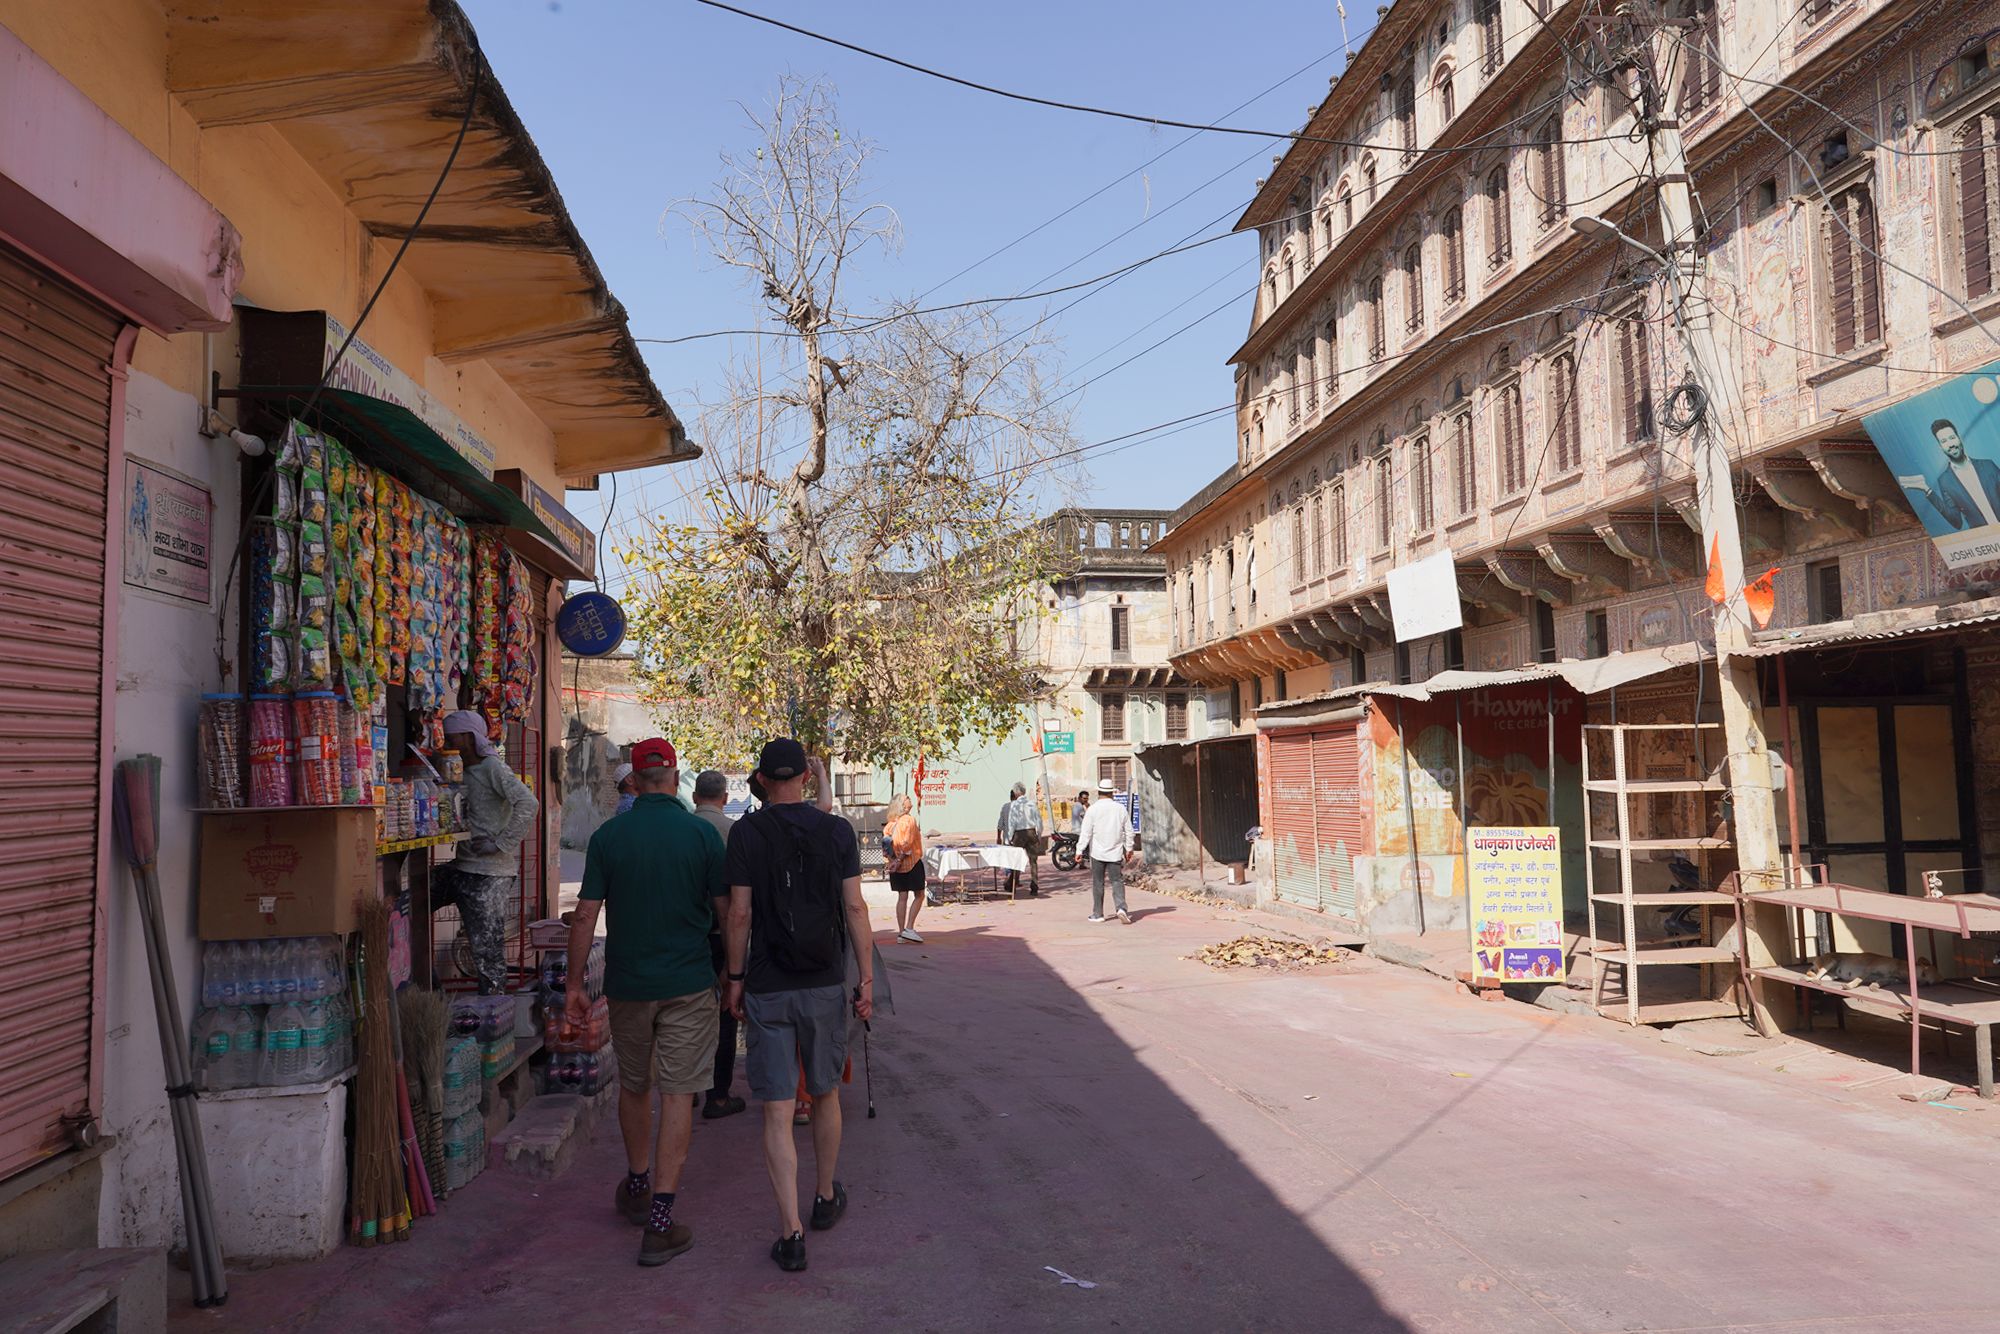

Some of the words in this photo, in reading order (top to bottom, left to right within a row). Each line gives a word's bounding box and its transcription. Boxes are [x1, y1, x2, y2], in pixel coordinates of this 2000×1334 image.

[155, 530, 171, 547] भव्य
[172, 533, 189, 552] शोभा
[190, 542, 206, 558] यात्रा
[1950, 548, 1975, 562] JOSHI
[582, 599, 608, 641] TECNO
[1494, 719, 1515, 730] ICE
[1474, 838, 1514, 857] धानुका
[1515, 834, 1556, 851] एजेन्सी
